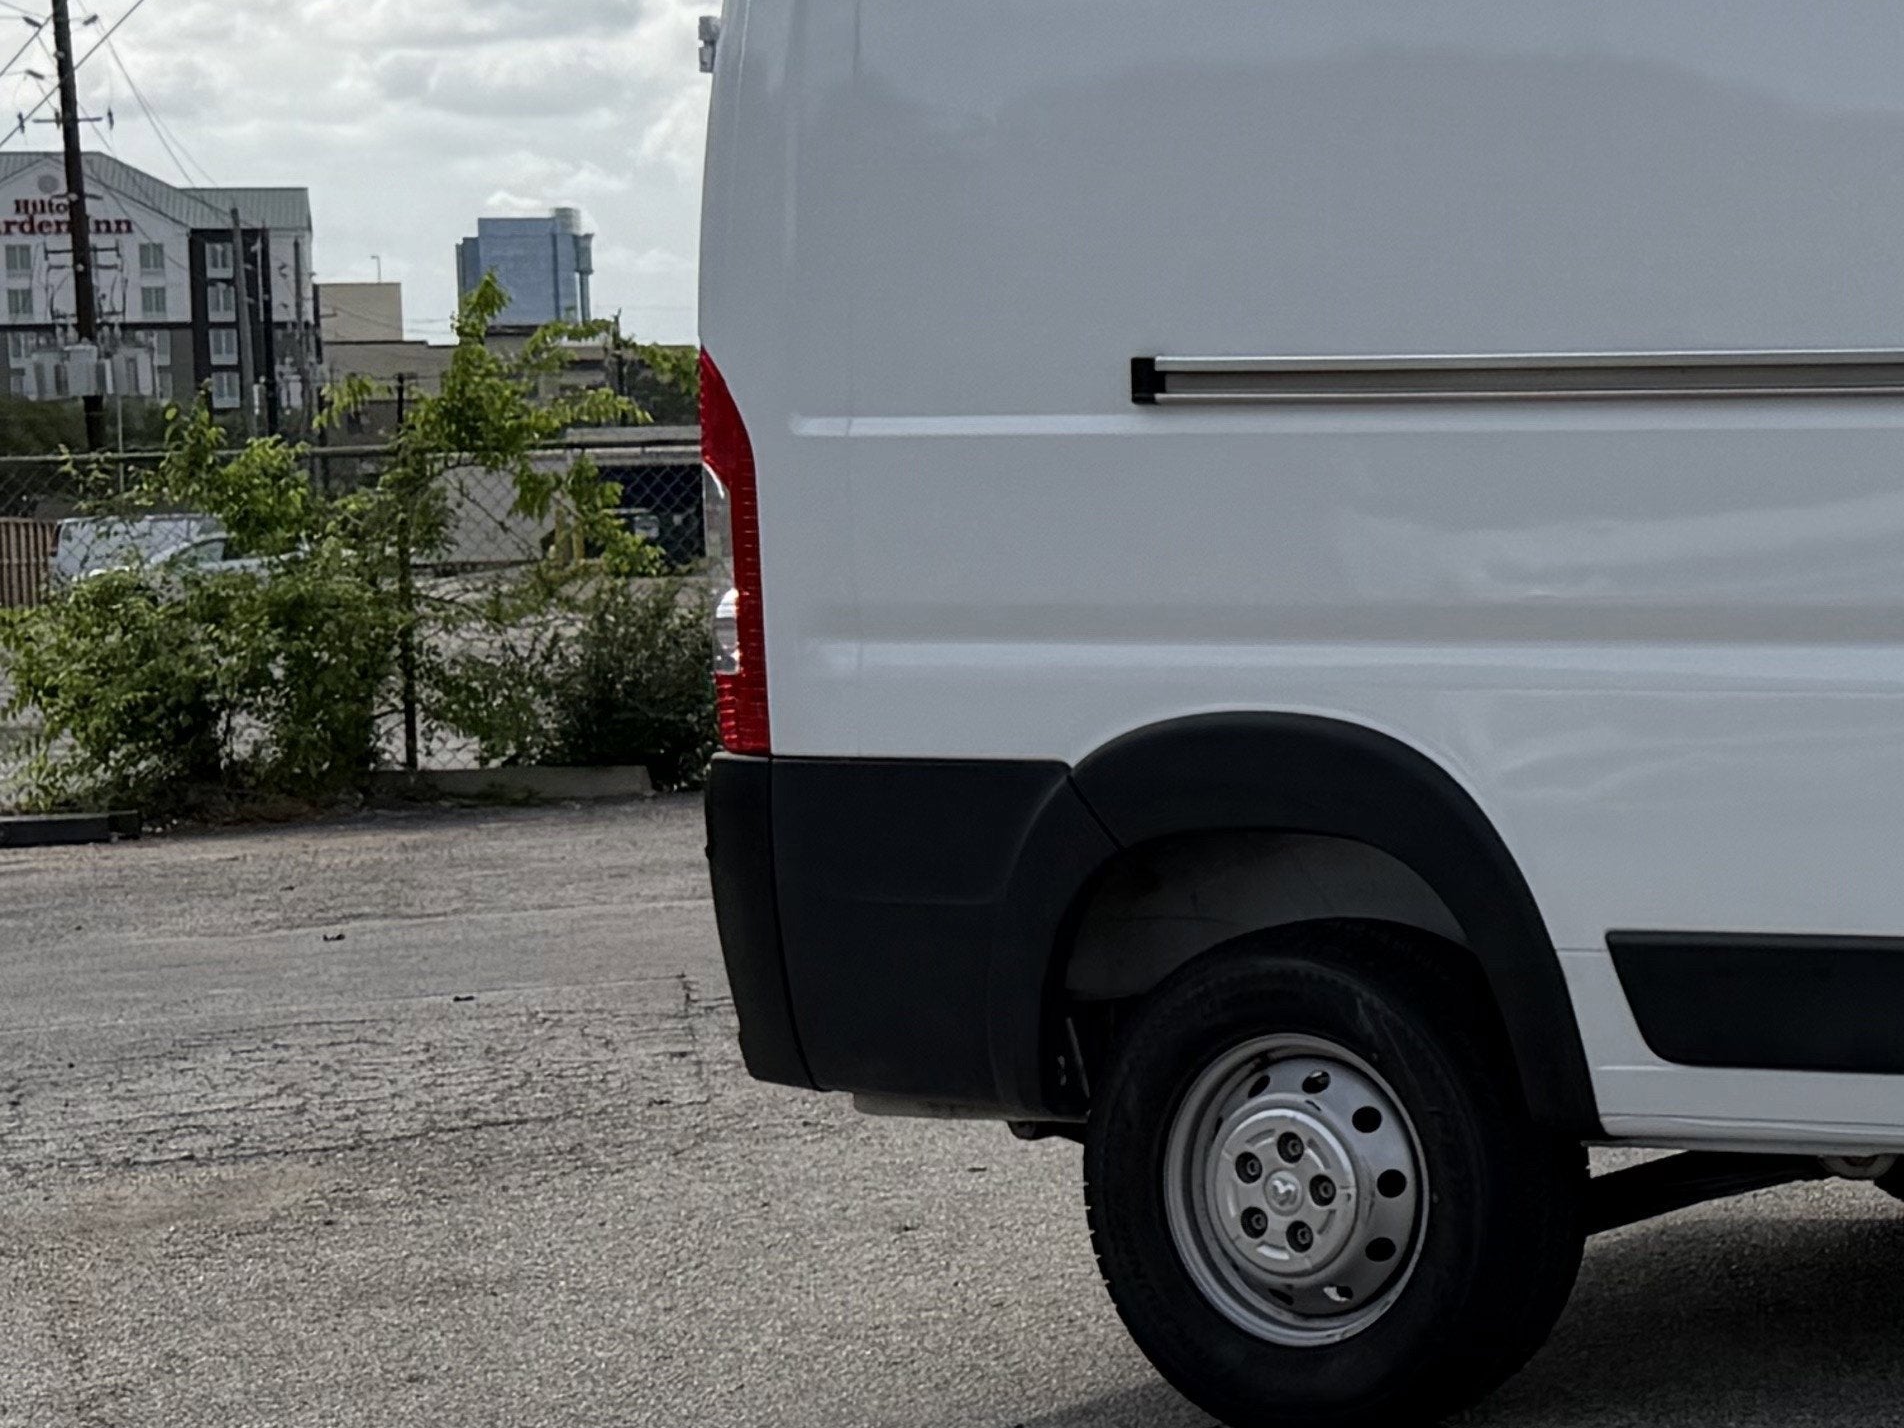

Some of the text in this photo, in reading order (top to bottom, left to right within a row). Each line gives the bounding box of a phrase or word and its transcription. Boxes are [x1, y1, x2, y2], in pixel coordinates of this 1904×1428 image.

[14, 198, 69, 215] Hilto
[0, 214, 134, 236] rden nn
